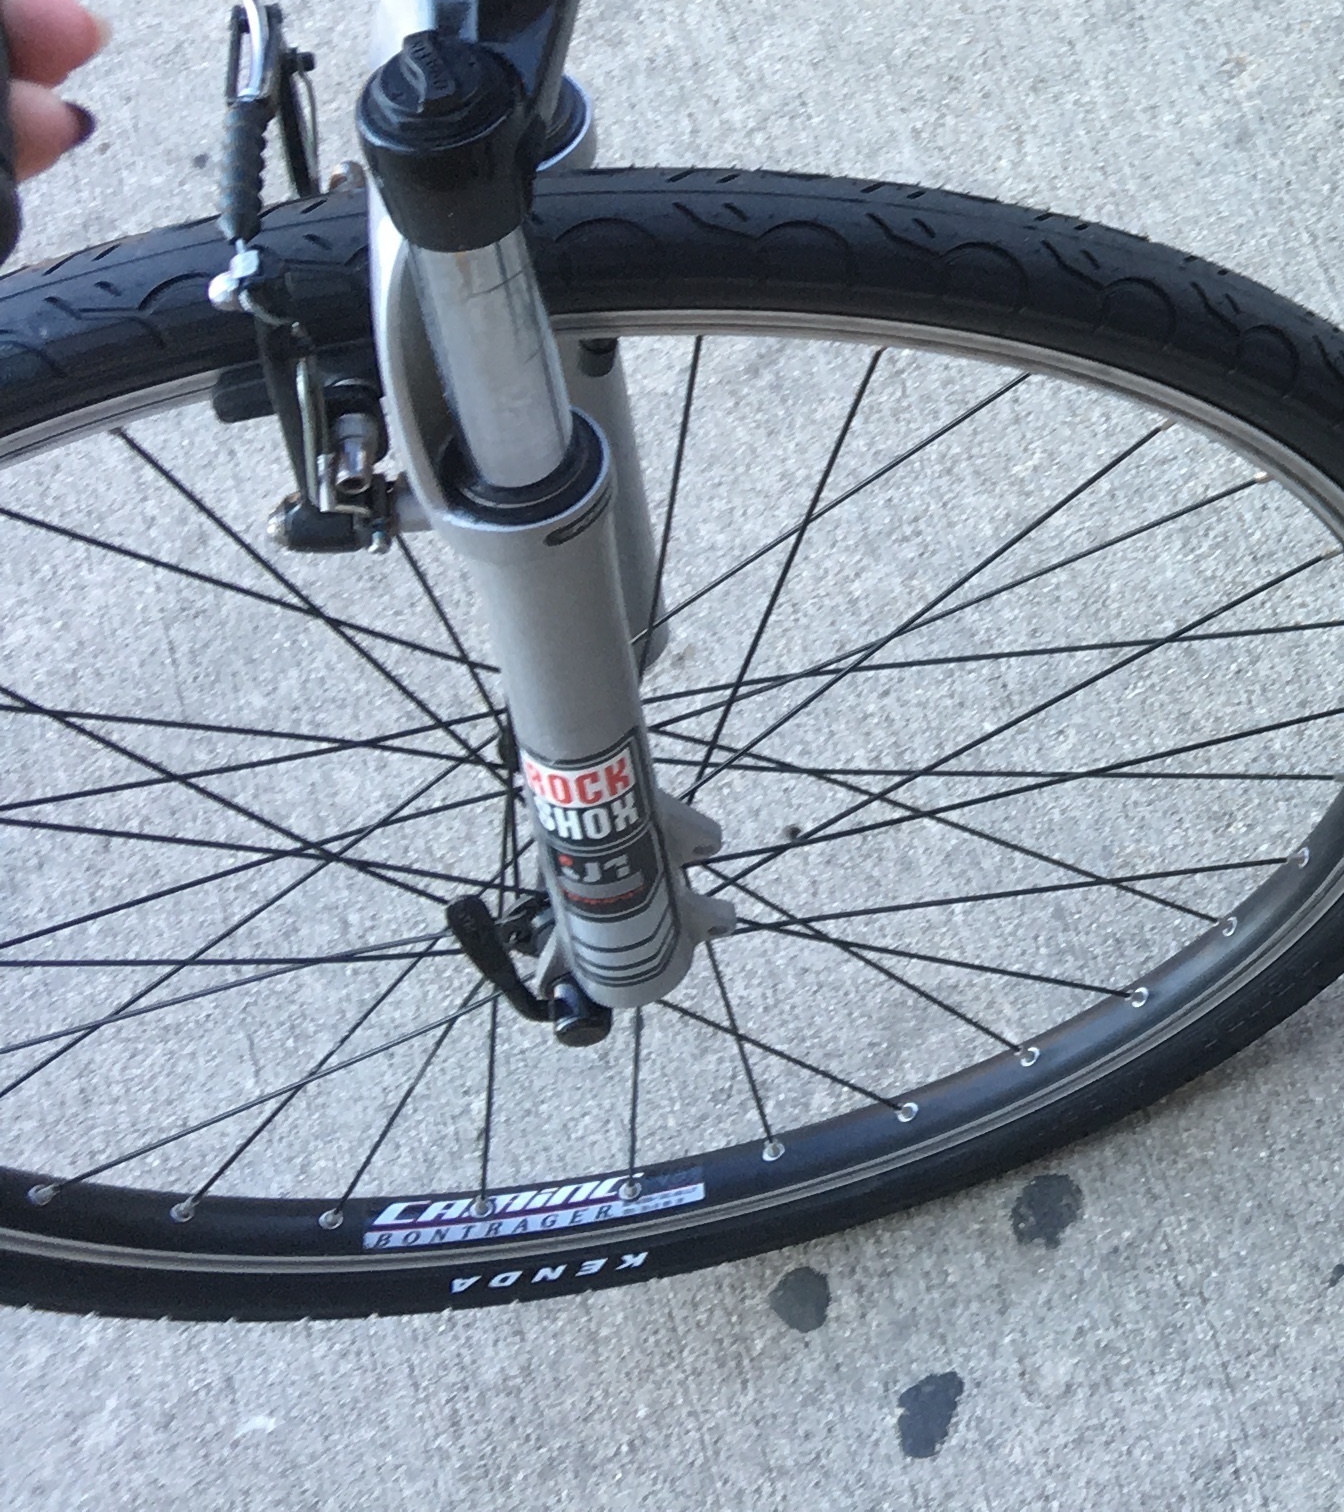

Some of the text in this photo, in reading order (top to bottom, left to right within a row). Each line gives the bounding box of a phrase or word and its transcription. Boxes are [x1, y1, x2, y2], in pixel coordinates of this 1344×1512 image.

[525, 757, 629, 805] ROCK
[534, 791, 639, 840] SHOX
[374, 1204, 612, 1248] BONTRAGER
[451, 1251, 649, 1294] KENDA
